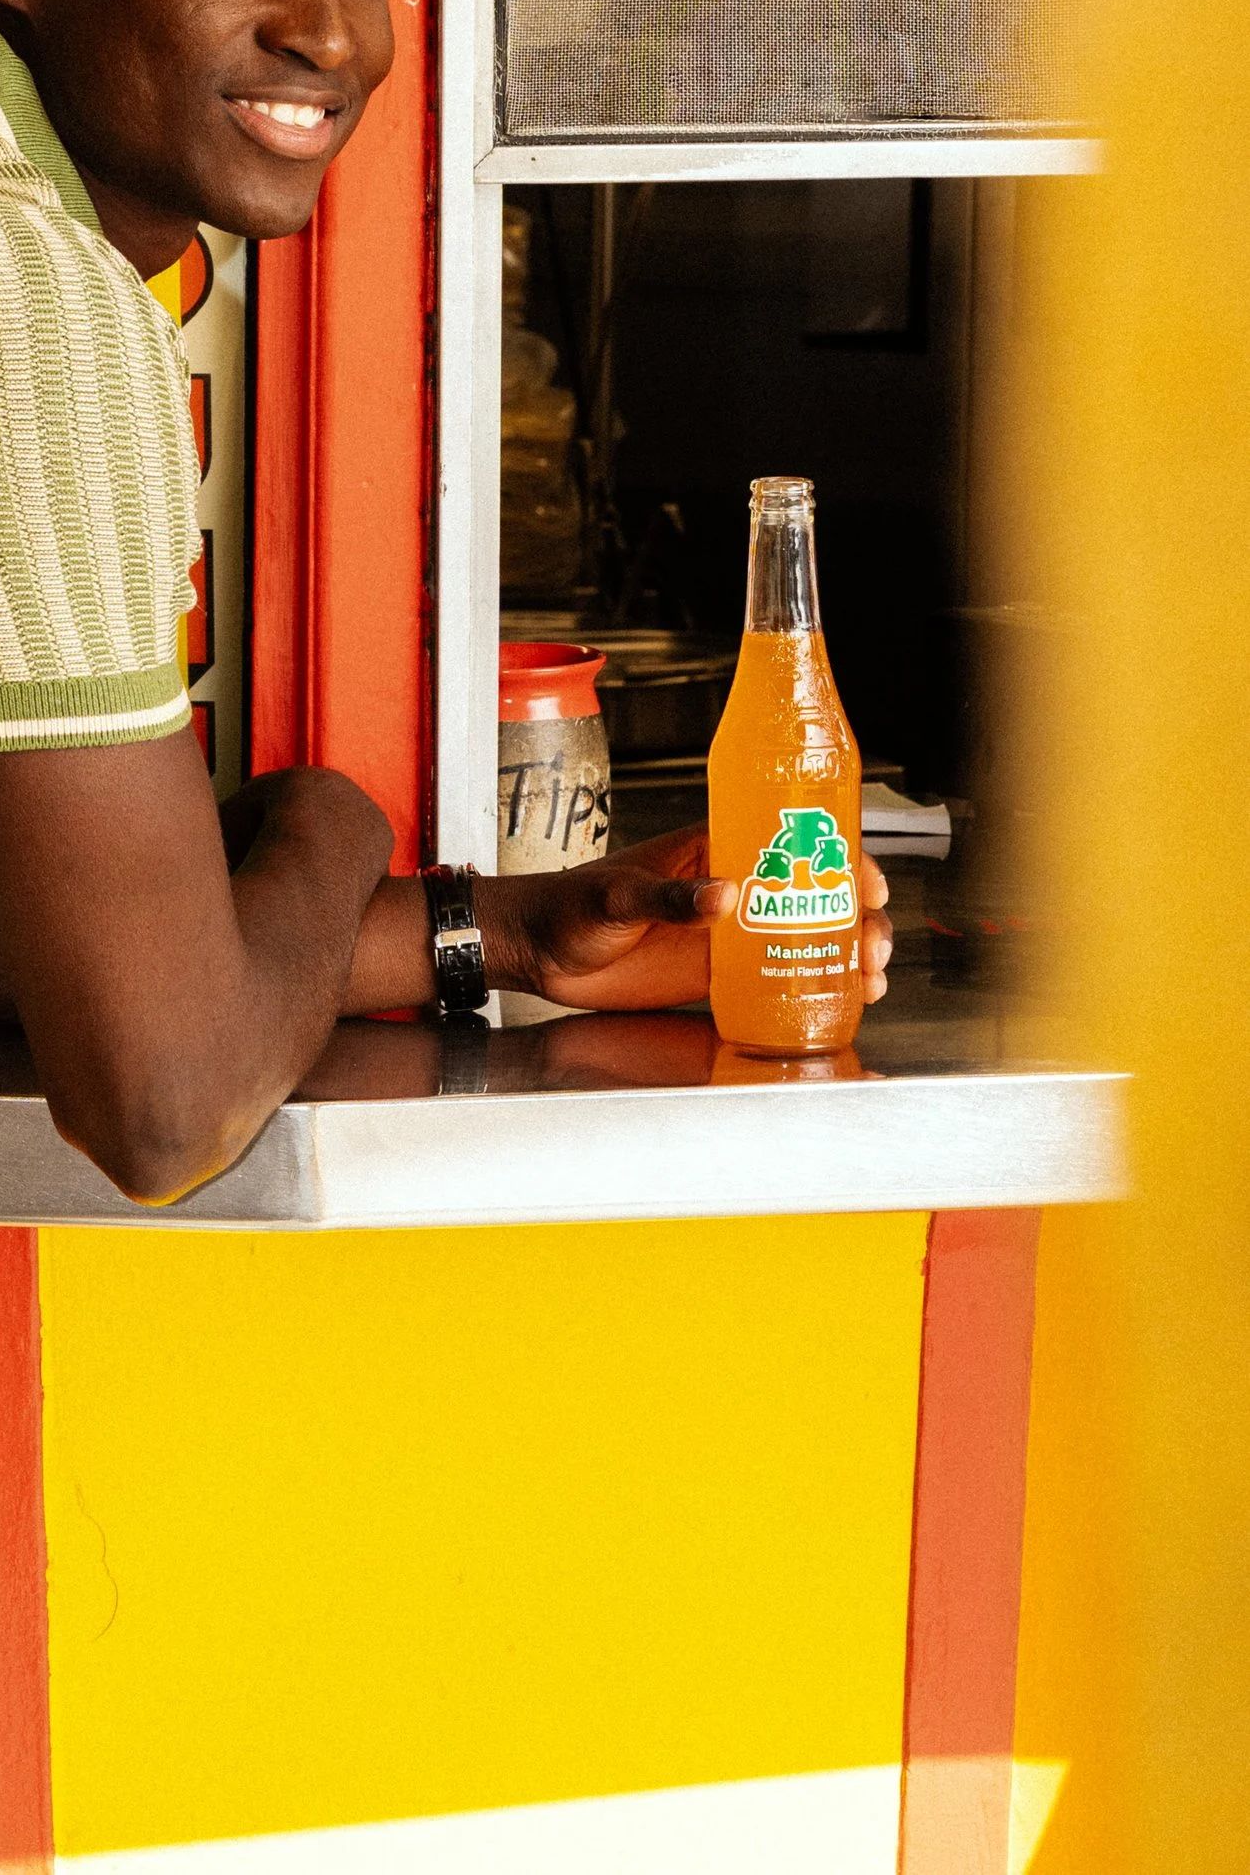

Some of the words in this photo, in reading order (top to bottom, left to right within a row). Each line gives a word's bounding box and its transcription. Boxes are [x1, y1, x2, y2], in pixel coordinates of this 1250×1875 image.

[750, 892, 849, 917] JARRITOS
[766, 942, 841, 960] Mandarin
[761, 966, 795, 977] Natural
[797, 966, 824, 977] Flavor
[826, 963, 845, 975] Soda
